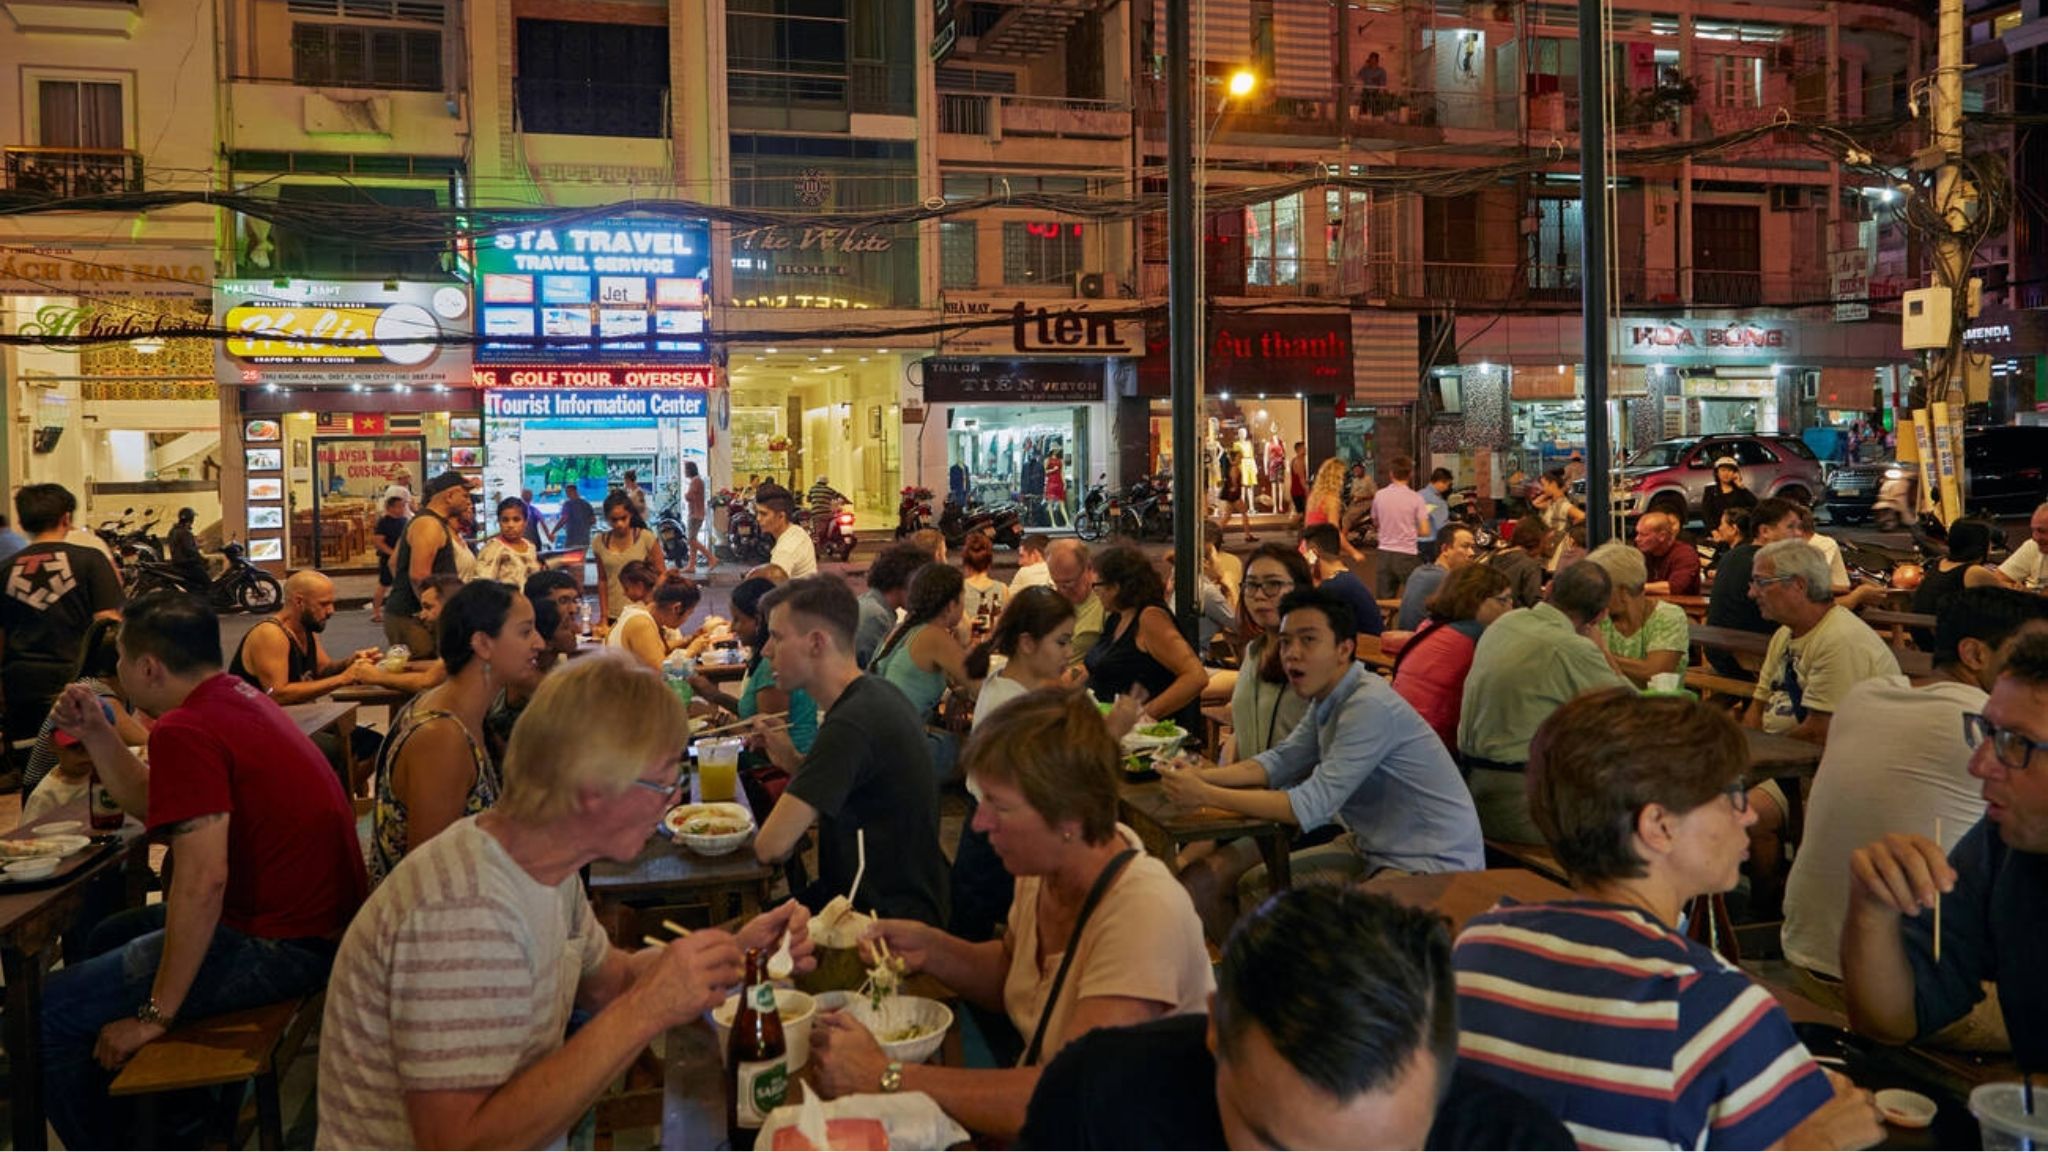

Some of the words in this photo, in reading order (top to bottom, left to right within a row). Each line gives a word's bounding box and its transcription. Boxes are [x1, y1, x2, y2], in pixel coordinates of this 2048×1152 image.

[495, 229, 558, 250] STA
[569, 229, 693, 254] TRAVEL
[800, 226, 892, 253] White
[0, 256, 62, 282] ÁCH
[513, 254, 590, 271] TRAVEL
[594, 255, 675, 274] SERVICE
[223, 284, 263, 295] HALAL
[602, 285, 628, 302] Jet
[943, 301, 966, 314] NHÀ
[967, 302, 991, 314] MAY
[1963, 325, 2010, 341] MENDA
[1259, 330, 1346, 358] thanh
[242, 369, 258, 381] 25
[931, 363, 981, 374] TAILOR
[510, 371, 558, 387] GOLF
[561, 371, 612, 387] TOUR
[624, 371, 705, 387] OVERSEA
[487, 392, 551, 415] Tourist
[555, 392, 646, 415] Information
[650, 393, 702, 415] Center
